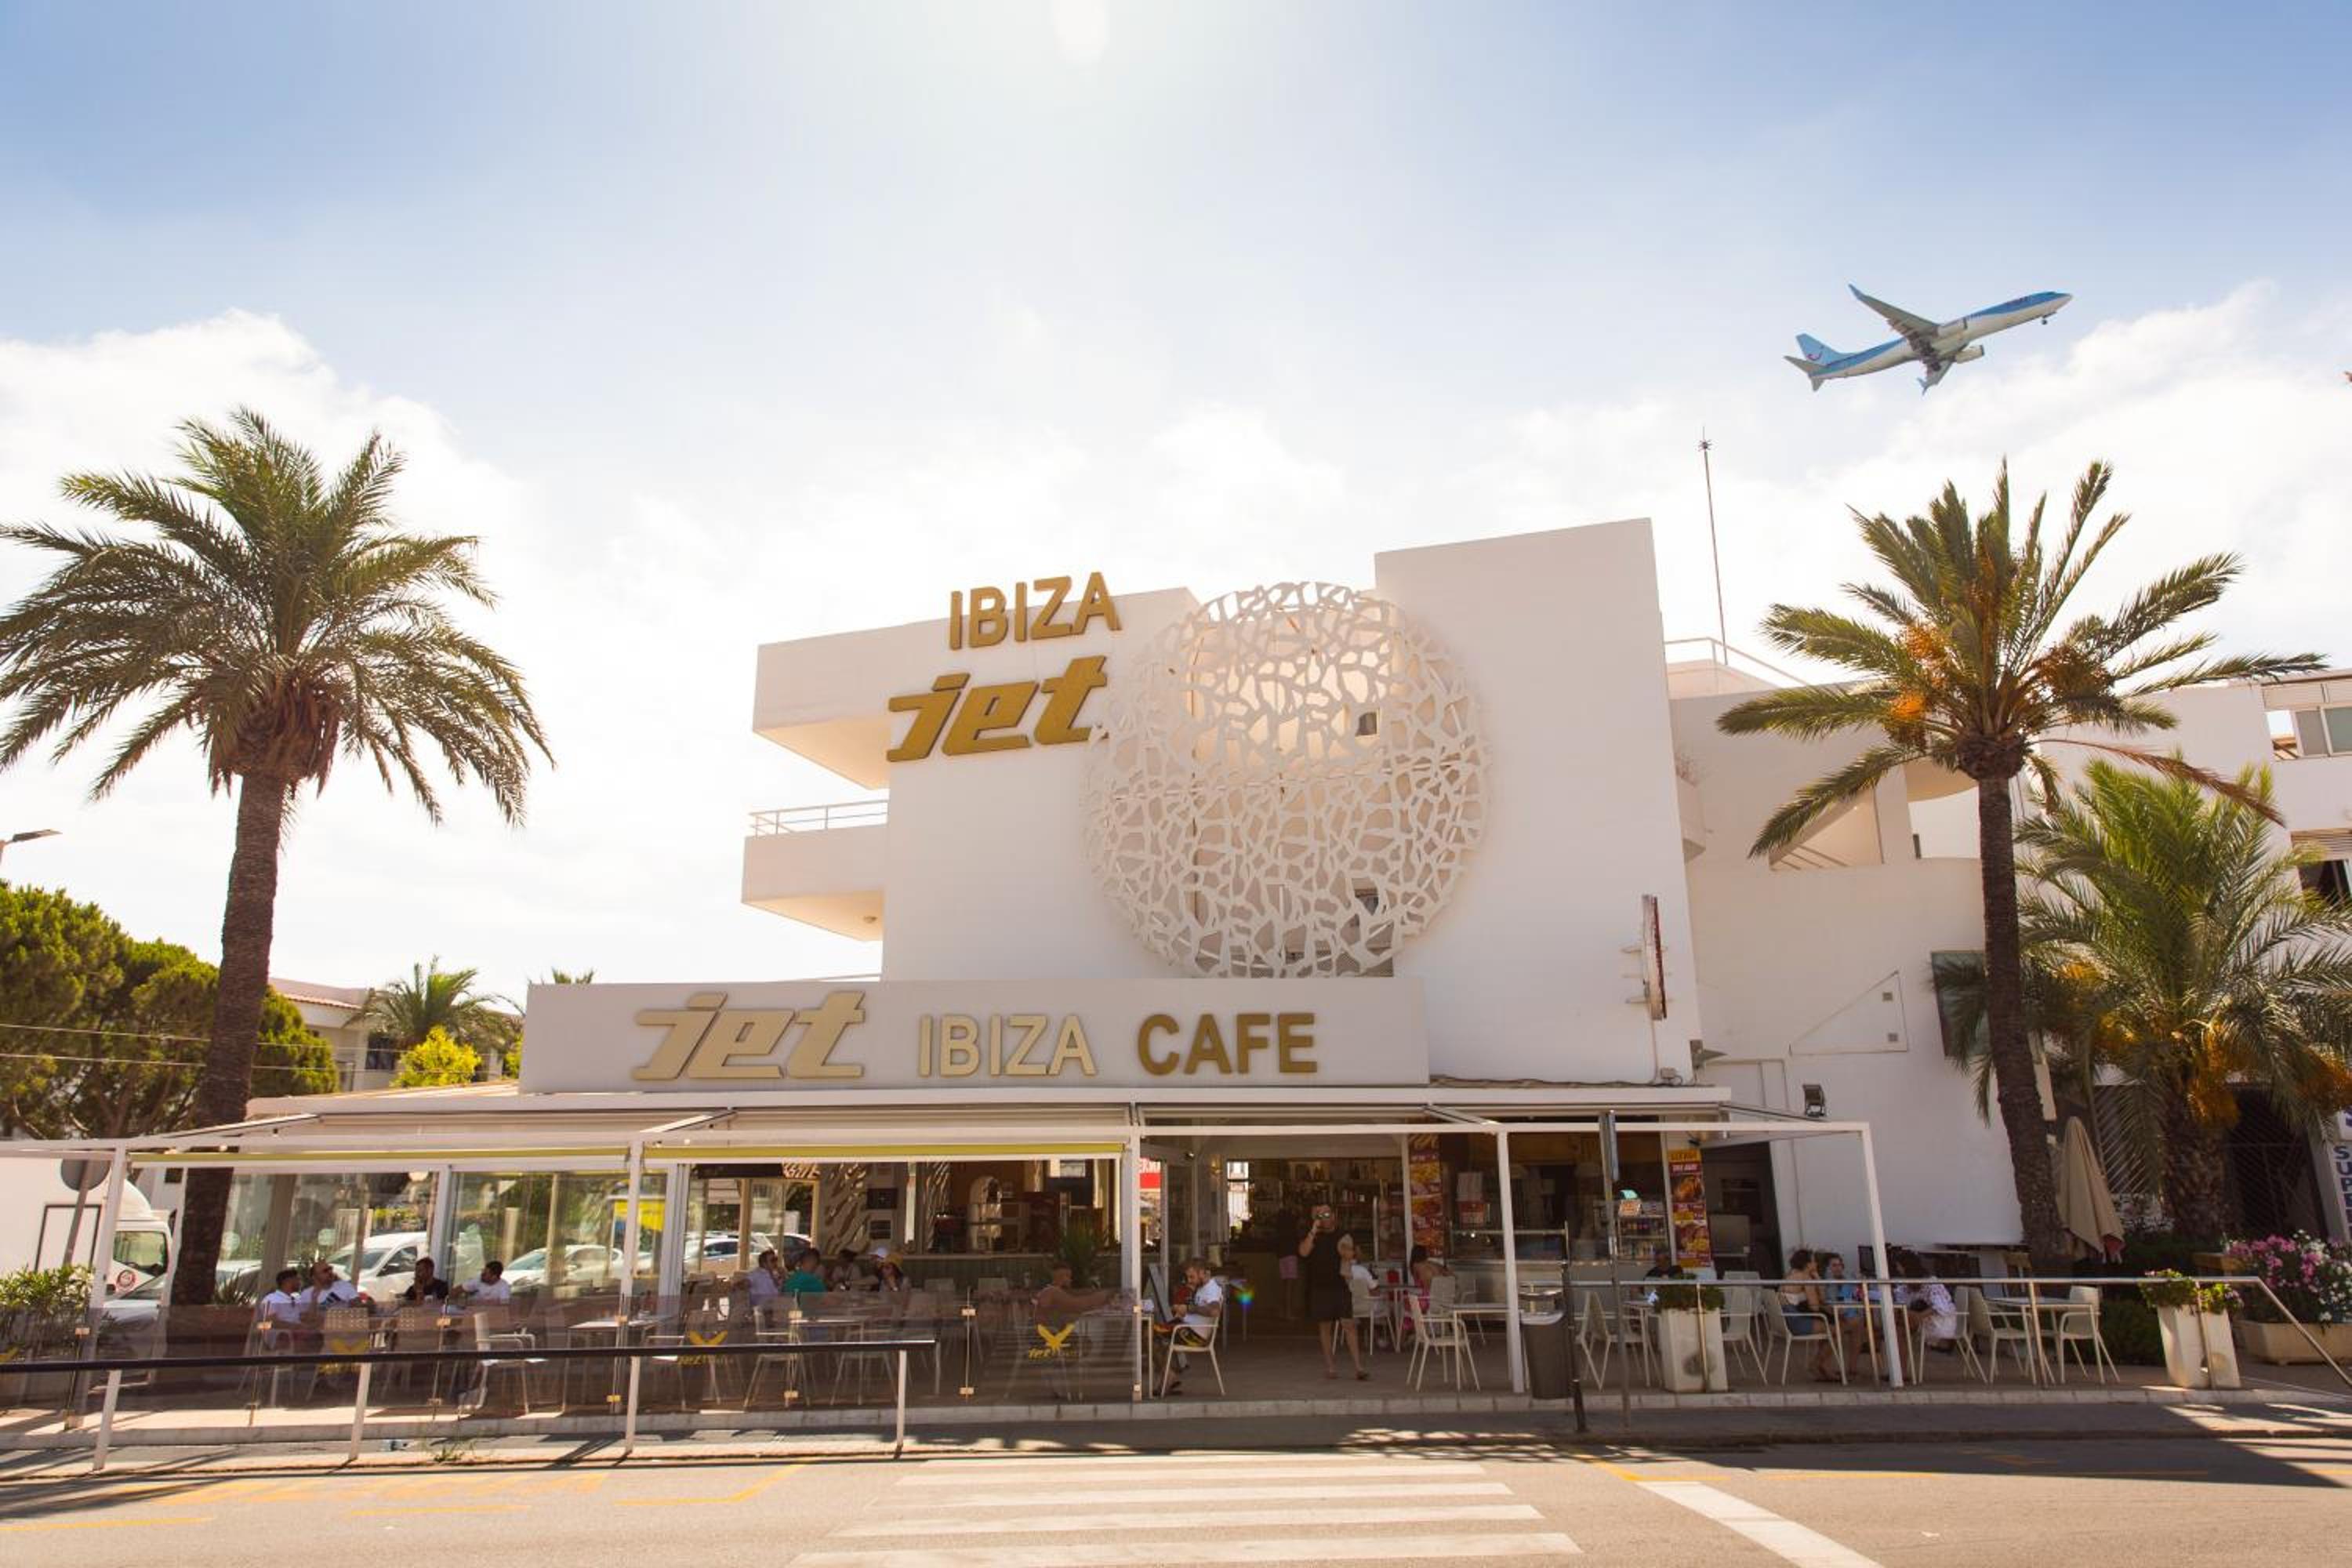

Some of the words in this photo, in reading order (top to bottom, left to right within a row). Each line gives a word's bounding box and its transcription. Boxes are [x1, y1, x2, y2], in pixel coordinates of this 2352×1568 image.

[949, 572, 1122, 650] IBIZA
[886, 655, 1108, 762] jet
[632, 990, 866, 1080] jet
[919, 1014, 1098, 1077] IBIZA
[1137, 1012, 1318, 1076] CAFE
